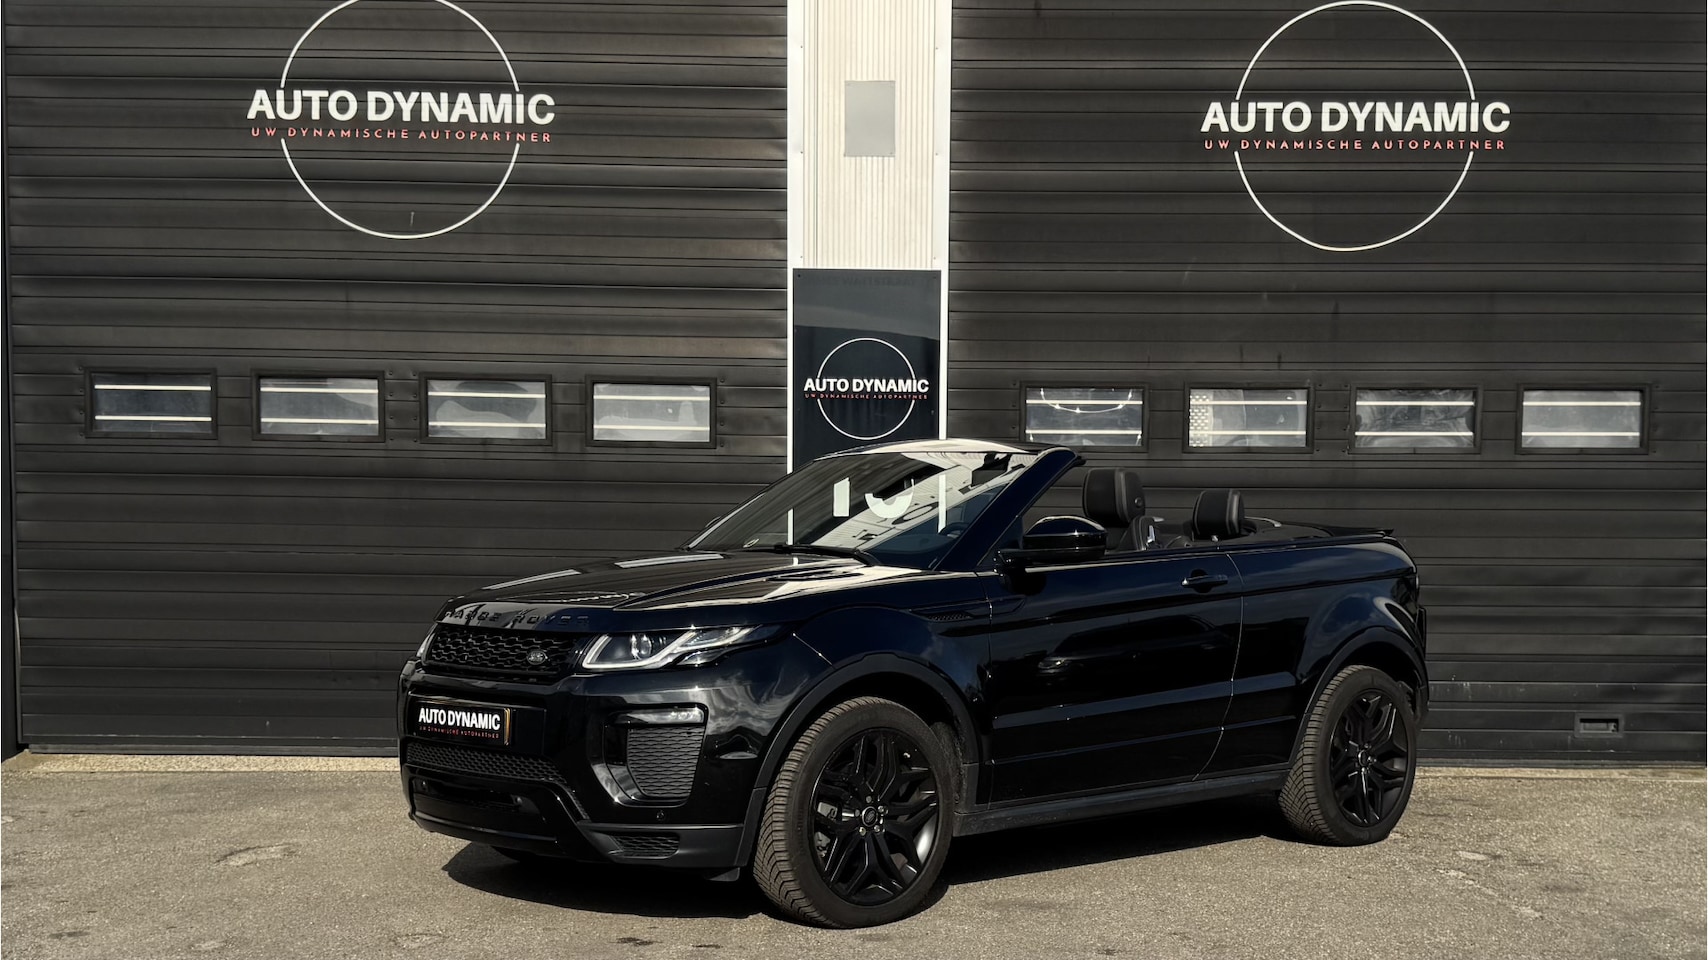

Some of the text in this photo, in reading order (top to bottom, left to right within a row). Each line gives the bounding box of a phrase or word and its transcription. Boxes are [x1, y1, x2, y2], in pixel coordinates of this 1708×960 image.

[247, 89, 556, 125] AUTO DYNAMIC
[1200, 101, 1510, 133] AUTO DYNAMIC
[251, 127, 551, 143] UW DYNAMISCHE AUTOPARTNER
[1204, 139, 1506, 150] UW DYNAMISCHE AUTOPARTNER
[803, 378, 930, 393] AUTO DYNAMIC
[418, 707, 501, 731] AUTO DYNAMIC
